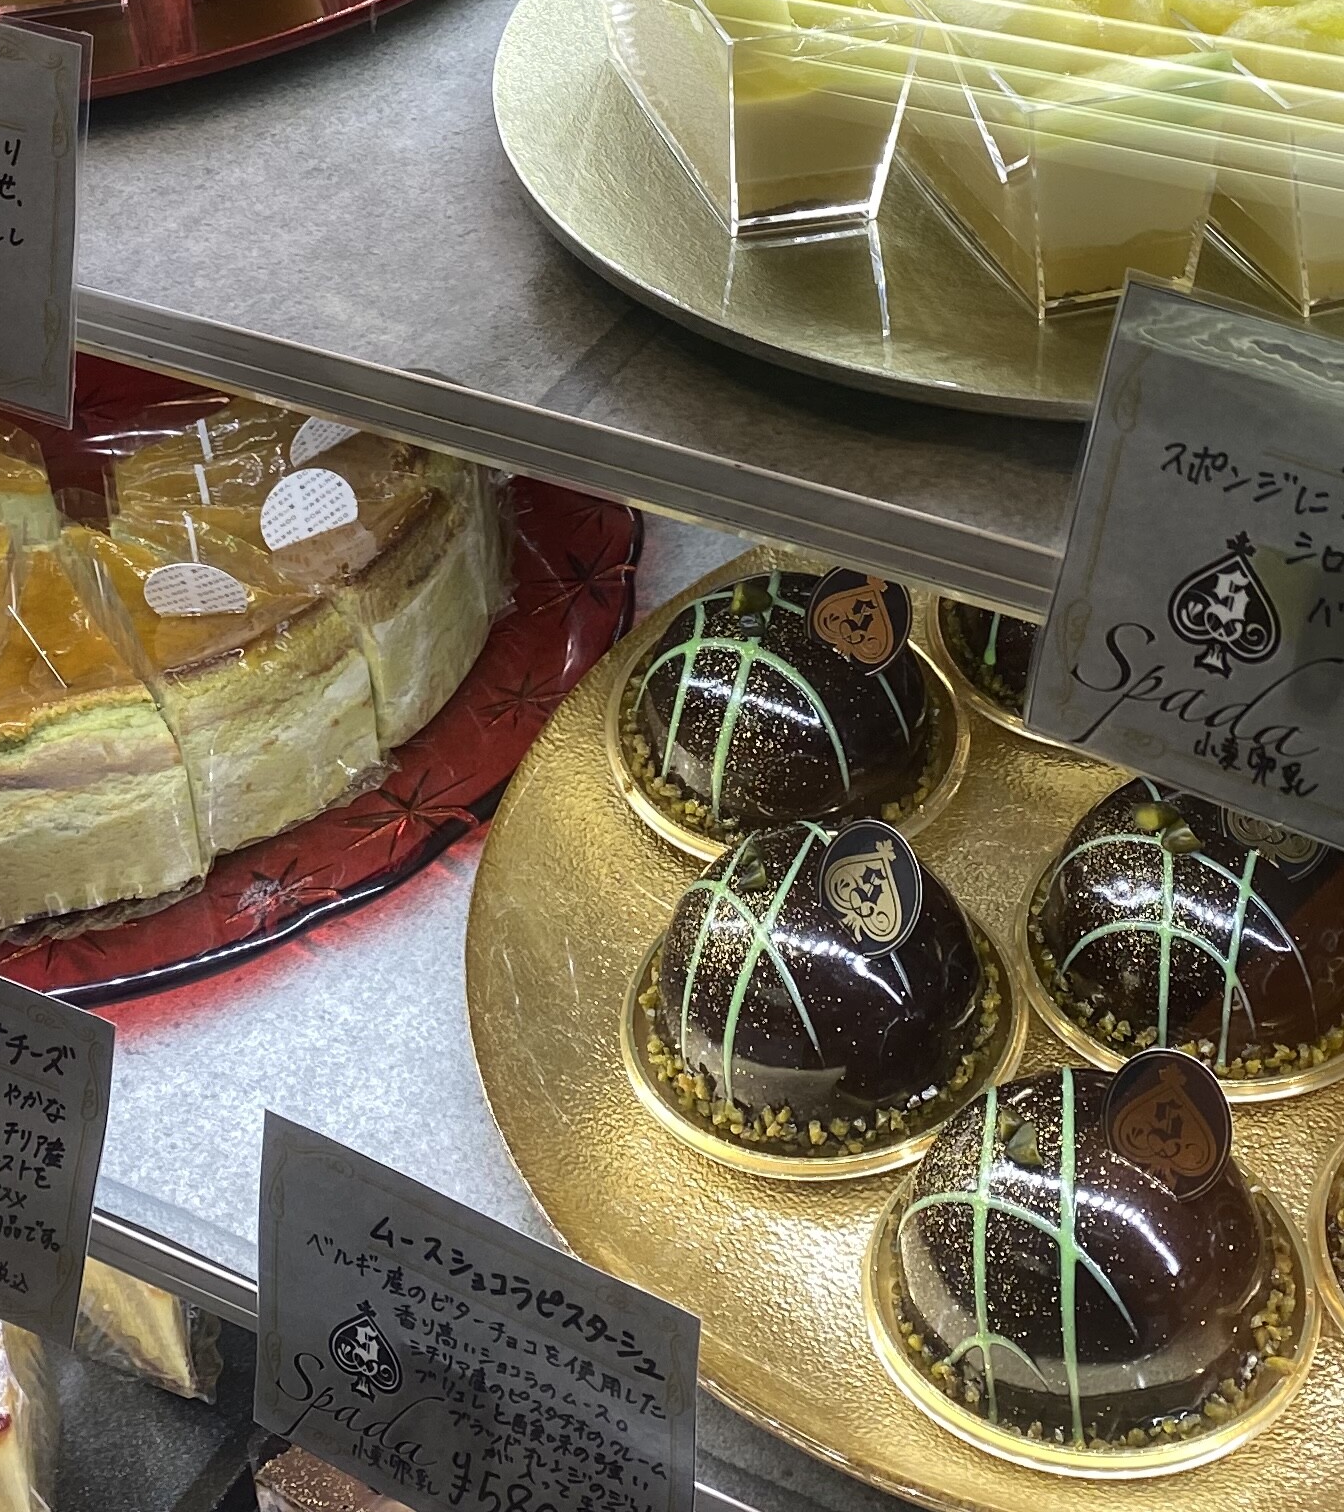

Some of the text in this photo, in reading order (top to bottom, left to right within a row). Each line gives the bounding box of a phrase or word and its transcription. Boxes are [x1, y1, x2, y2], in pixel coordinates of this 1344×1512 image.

[307, 1233, 667, 1420] ベルギー産のビターチョコを使用した
[369, 1216, 666, 1381] ムースショコラピスターシュ
[276, 1352, 447, 1465] Spada
